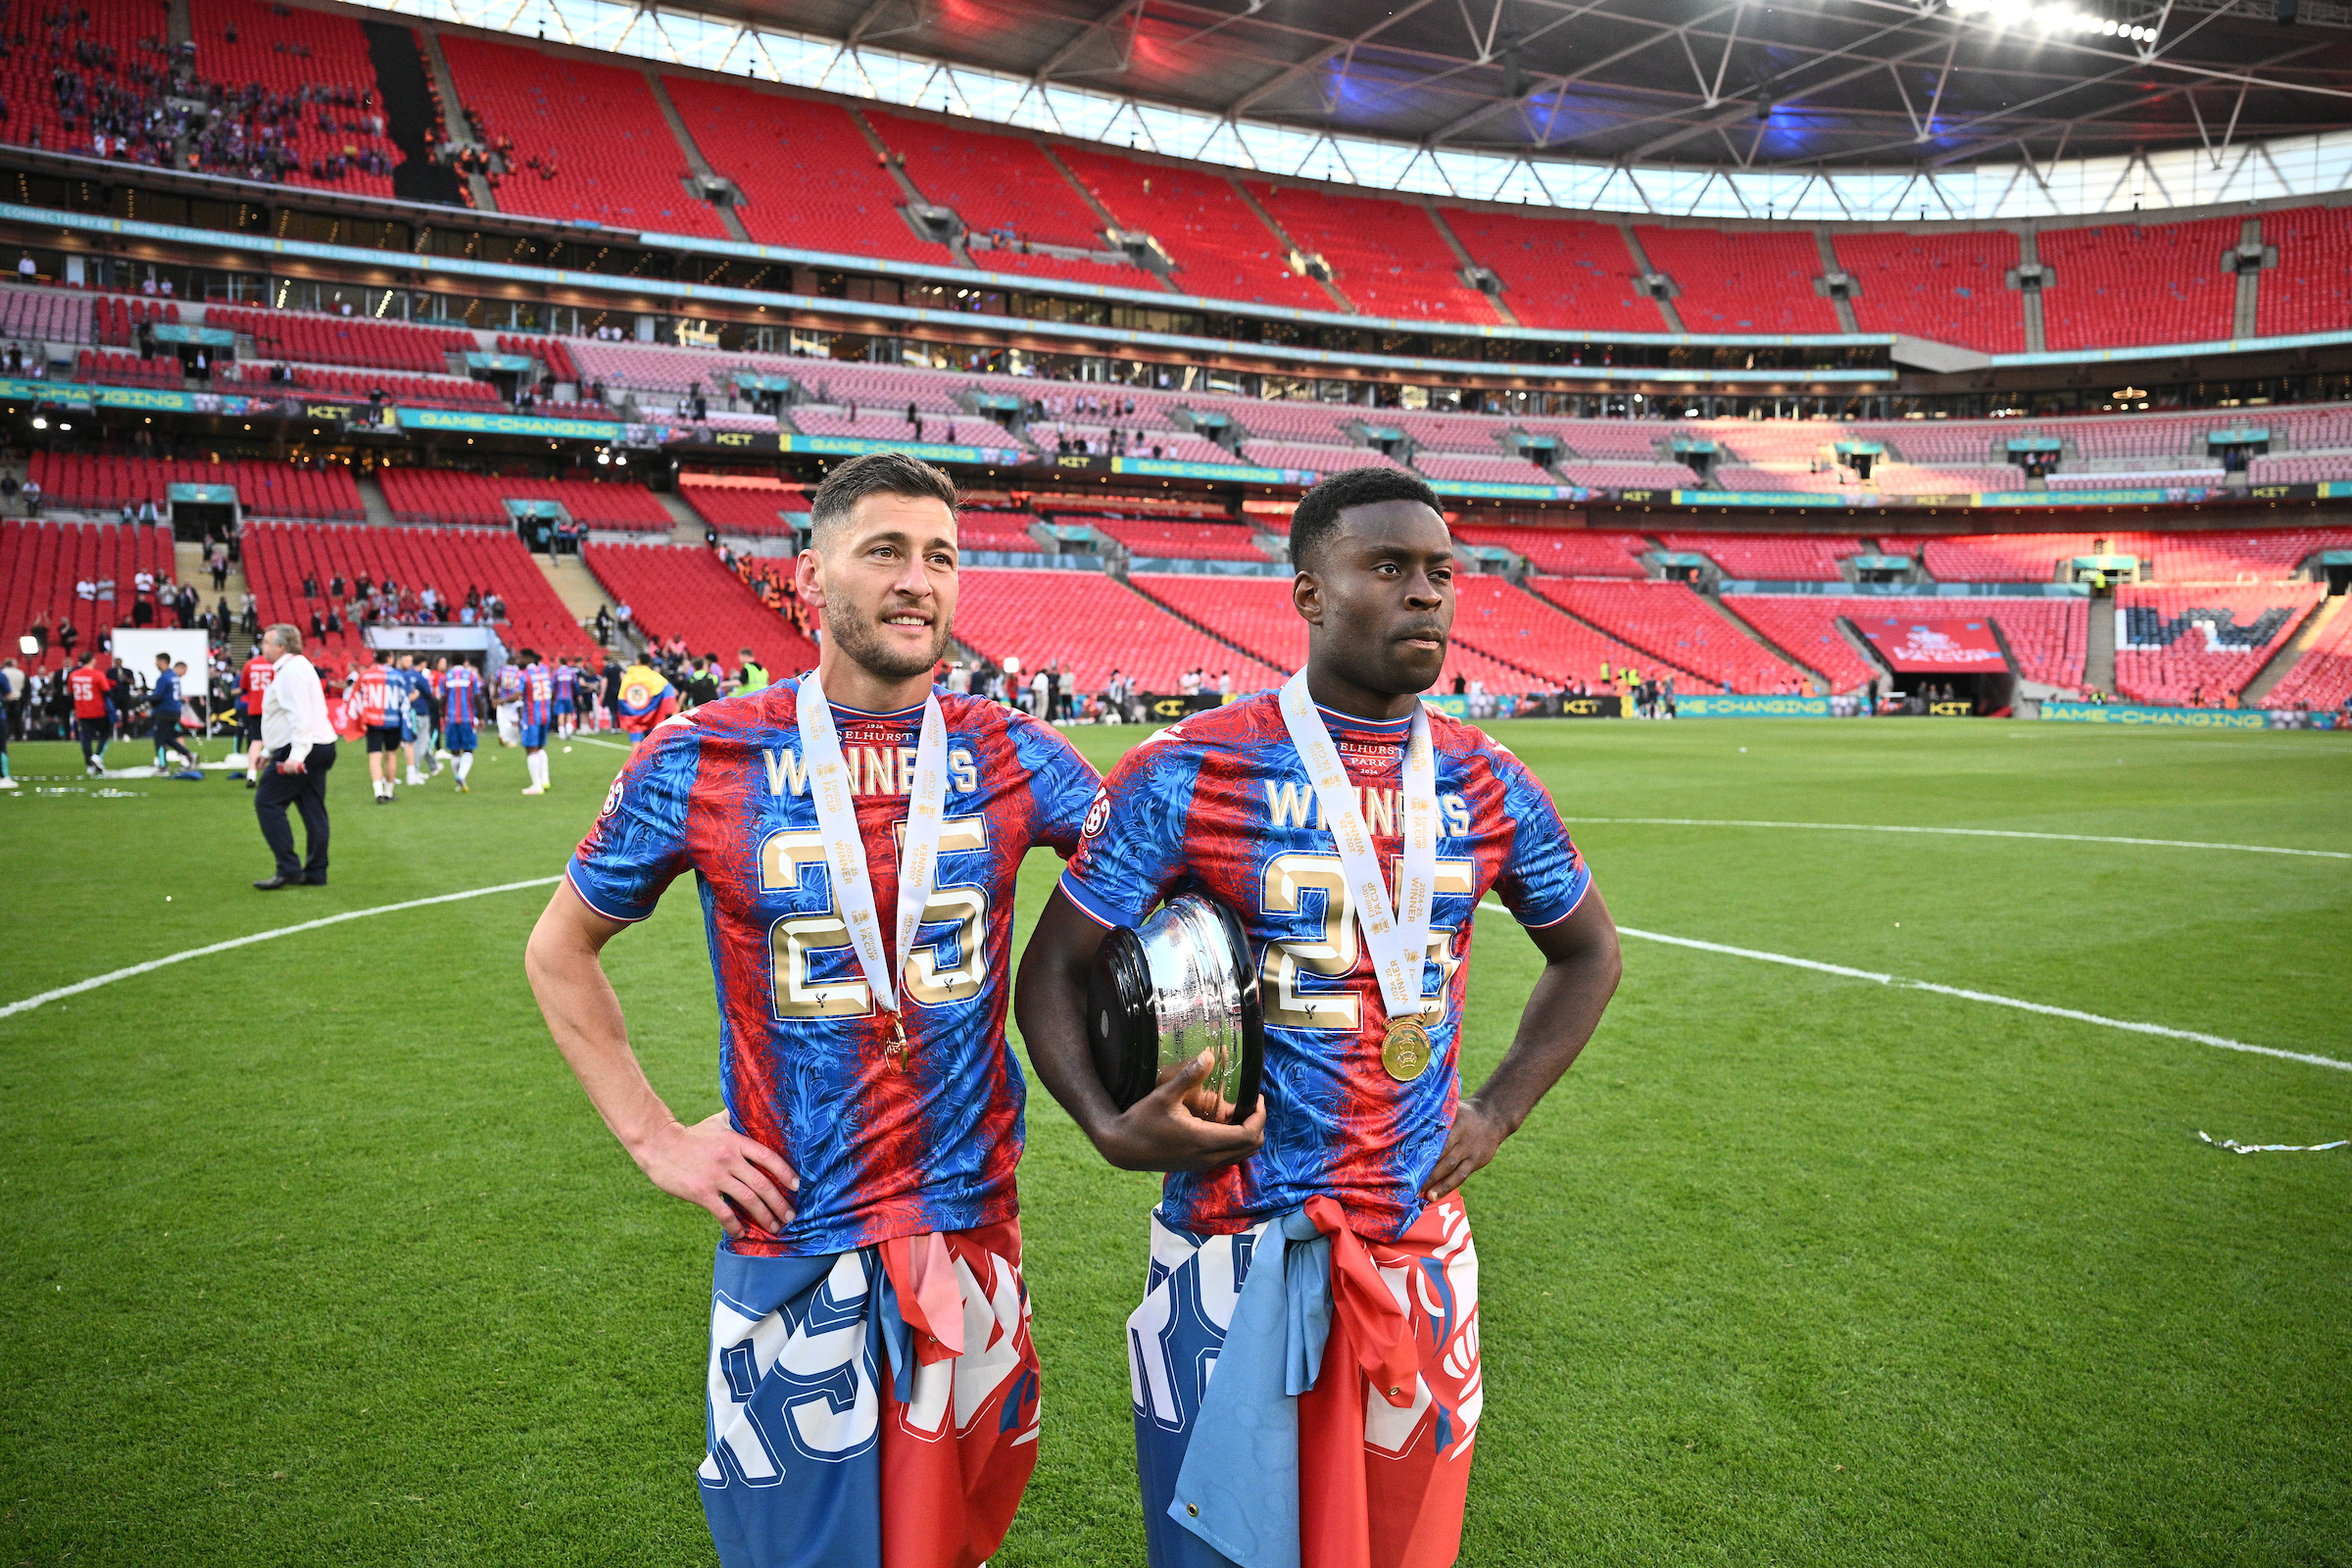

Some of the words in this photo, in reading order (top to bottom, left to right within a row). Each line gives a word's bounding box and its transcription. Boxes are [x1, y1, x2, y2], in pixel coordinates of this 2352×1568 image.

[307, 404, 351, 419] KIT
[420, 413, 616, 437] GAME-CHANGING
[716, 432, 754, 446] KIT
[1057, 456, 1090, 468] KIT
[1137, 461, 1279, 481] GAME-CHANGING
[1622, 491, 1652, 502] KIT
[1694, 492, 1838, 506] GAME-CHANGING
[1916, 494, 1948, 506] KIT
[1997, 492, 2159, 505] GAME-CHANGING
[2252, 486, 2289, 498] KIT
[72, 683, 93, 702] 25
[1296, 682, 1308, 718] WINNER
[1289, 691, 1299, 717] 2024-25
[1563, 699, 1597, 714] KIT
[1930, 702, 1972, 716] KIT
[807, 705, 820, 741] WINNER
[1308, 744, 1324, 773] Emirates
[1313, 741, 1327, 759] CUP
[1334, 742, 1404, 760] ELHURST
[1416, 735, 1427, 767] 2024-25
[1324, 758, 1333, 771] FA
[1351, 758, 1387, 767] PARK
[822, 781, 832, 795] FA
[830, 779, 843, 811] Emirates
[920, 770, 929, 800] Emirates
[927, 789, 935, 801] FA
[825, 795, 836, 813] CUP
[1414, 816, 1421, 827] FA
[1340, 819, 1356, 854] 2024-25
[1345, 811, 1365, 857] WINNER
[835, 839, 852, 885] WINNER
[845, 843, 858, 877] 2024-25
[908, 848, 919, 881] 2024-25
[913, 844, 929, 888] WINNER
[1361, 885, 1375, 917] Emirates
[1367, 882, 1381, 901] CUP
[1407, 877, 1420, 923] WINNER
[1416, 882, 1427, 917] 2024-25
[757, 811, 990, 1021] 25
[1372, 900, 1383, 915] FA
[858, 927, 869, 941] FA
[865, 926, 879, 960] Emirates
[863, 941, 875, 961] CUP
[1385, 968, 1400, 1002] 2024-25
[1391, 959, 1409, 1004] WINNER
